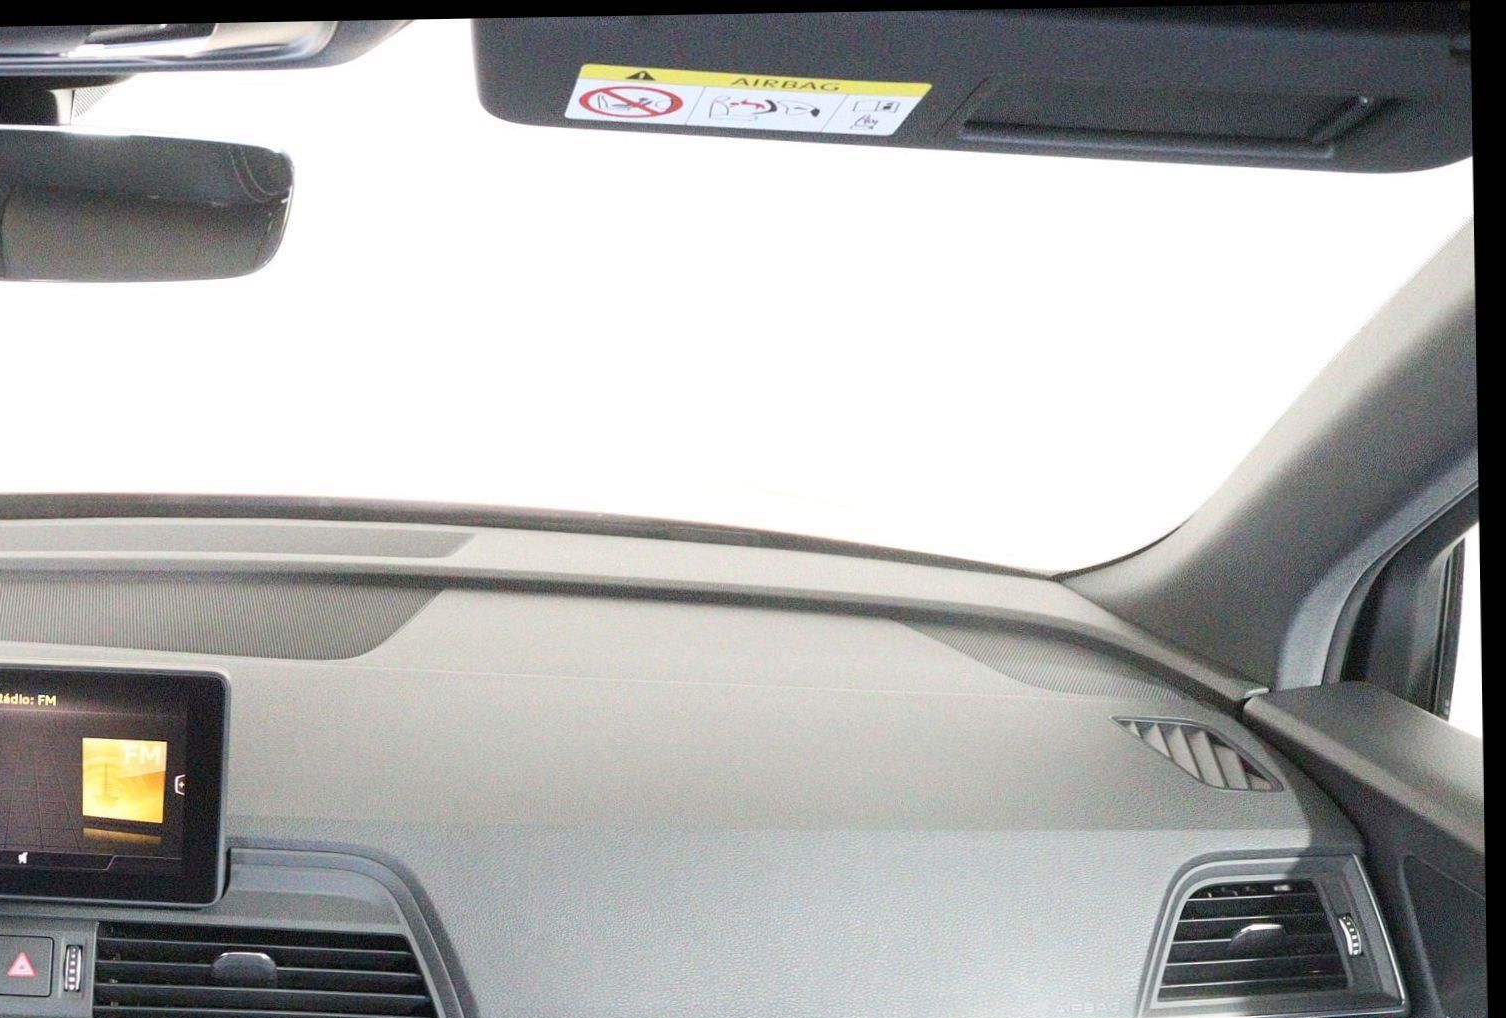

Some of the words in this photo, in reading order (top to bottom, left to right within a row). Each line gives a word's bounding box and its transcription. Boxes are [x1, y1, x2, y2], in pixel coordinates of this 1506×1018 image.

[732, 77, 841, 93] AIRBAG
[37, 694, 57, 706] FM
[124, 743, 162, 766] FM
